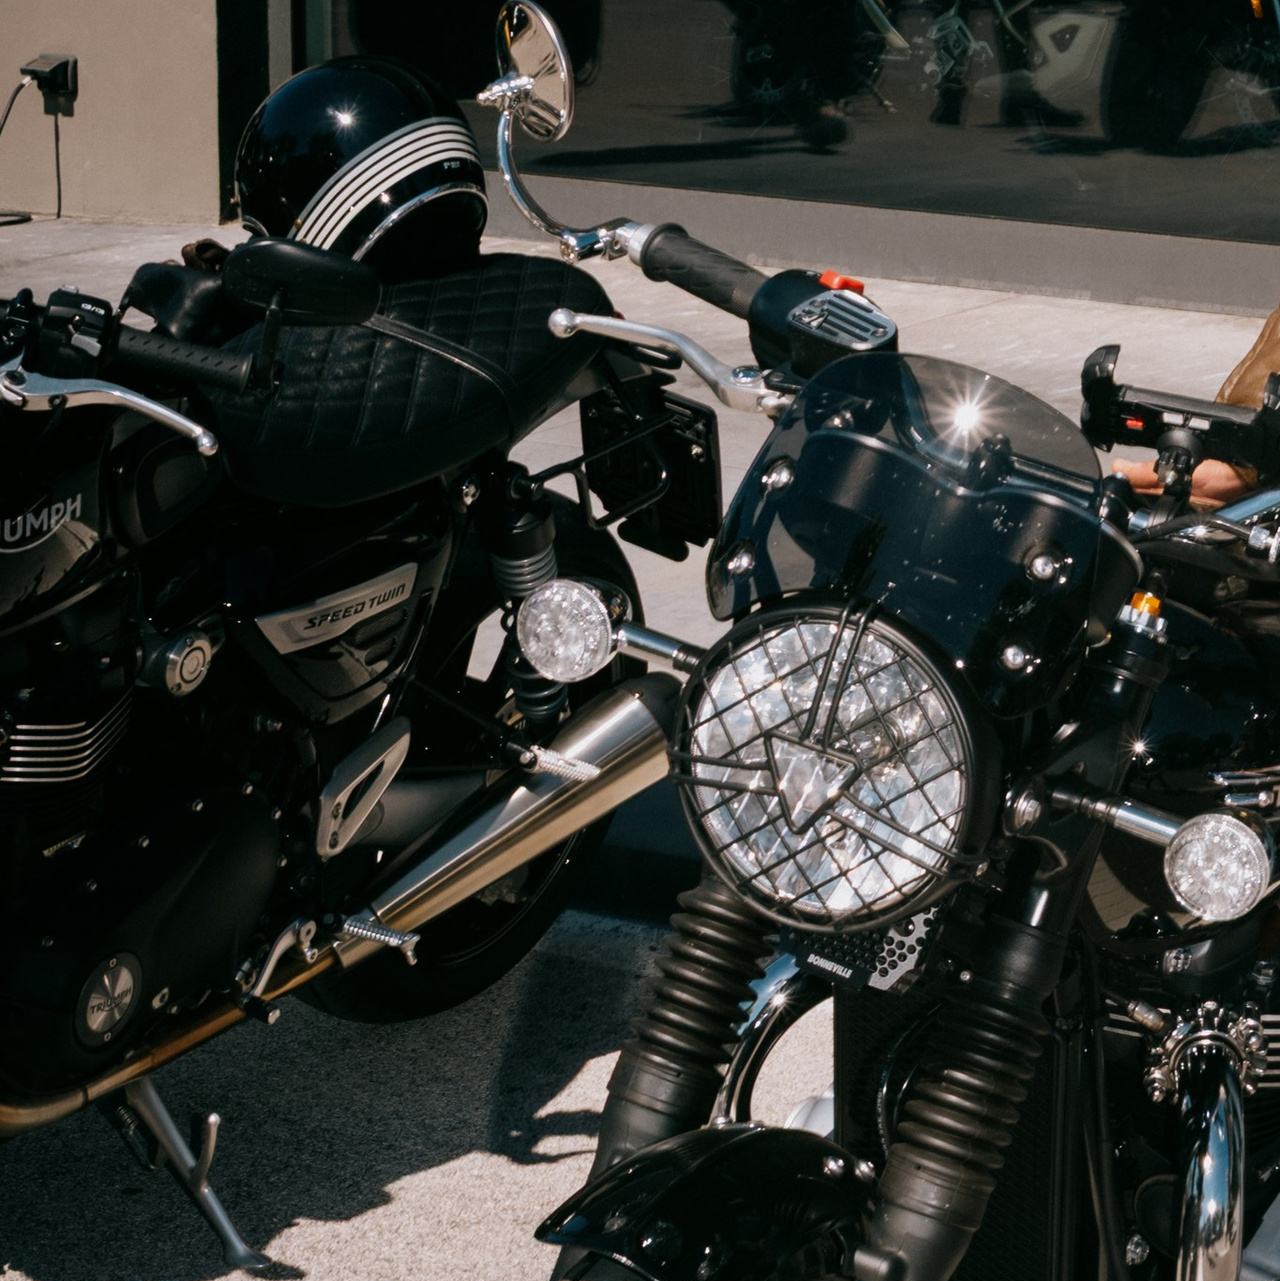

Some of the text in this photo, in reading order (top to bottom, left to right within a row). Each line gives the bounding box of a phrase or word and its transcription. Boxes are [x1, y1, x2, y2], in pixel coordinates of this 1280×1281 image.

[0, 493, 82, 543] UMPH
[304, 583, 407, 631] SPEED TWIN
[806, 953, 854, 979] BONNEVILLE
